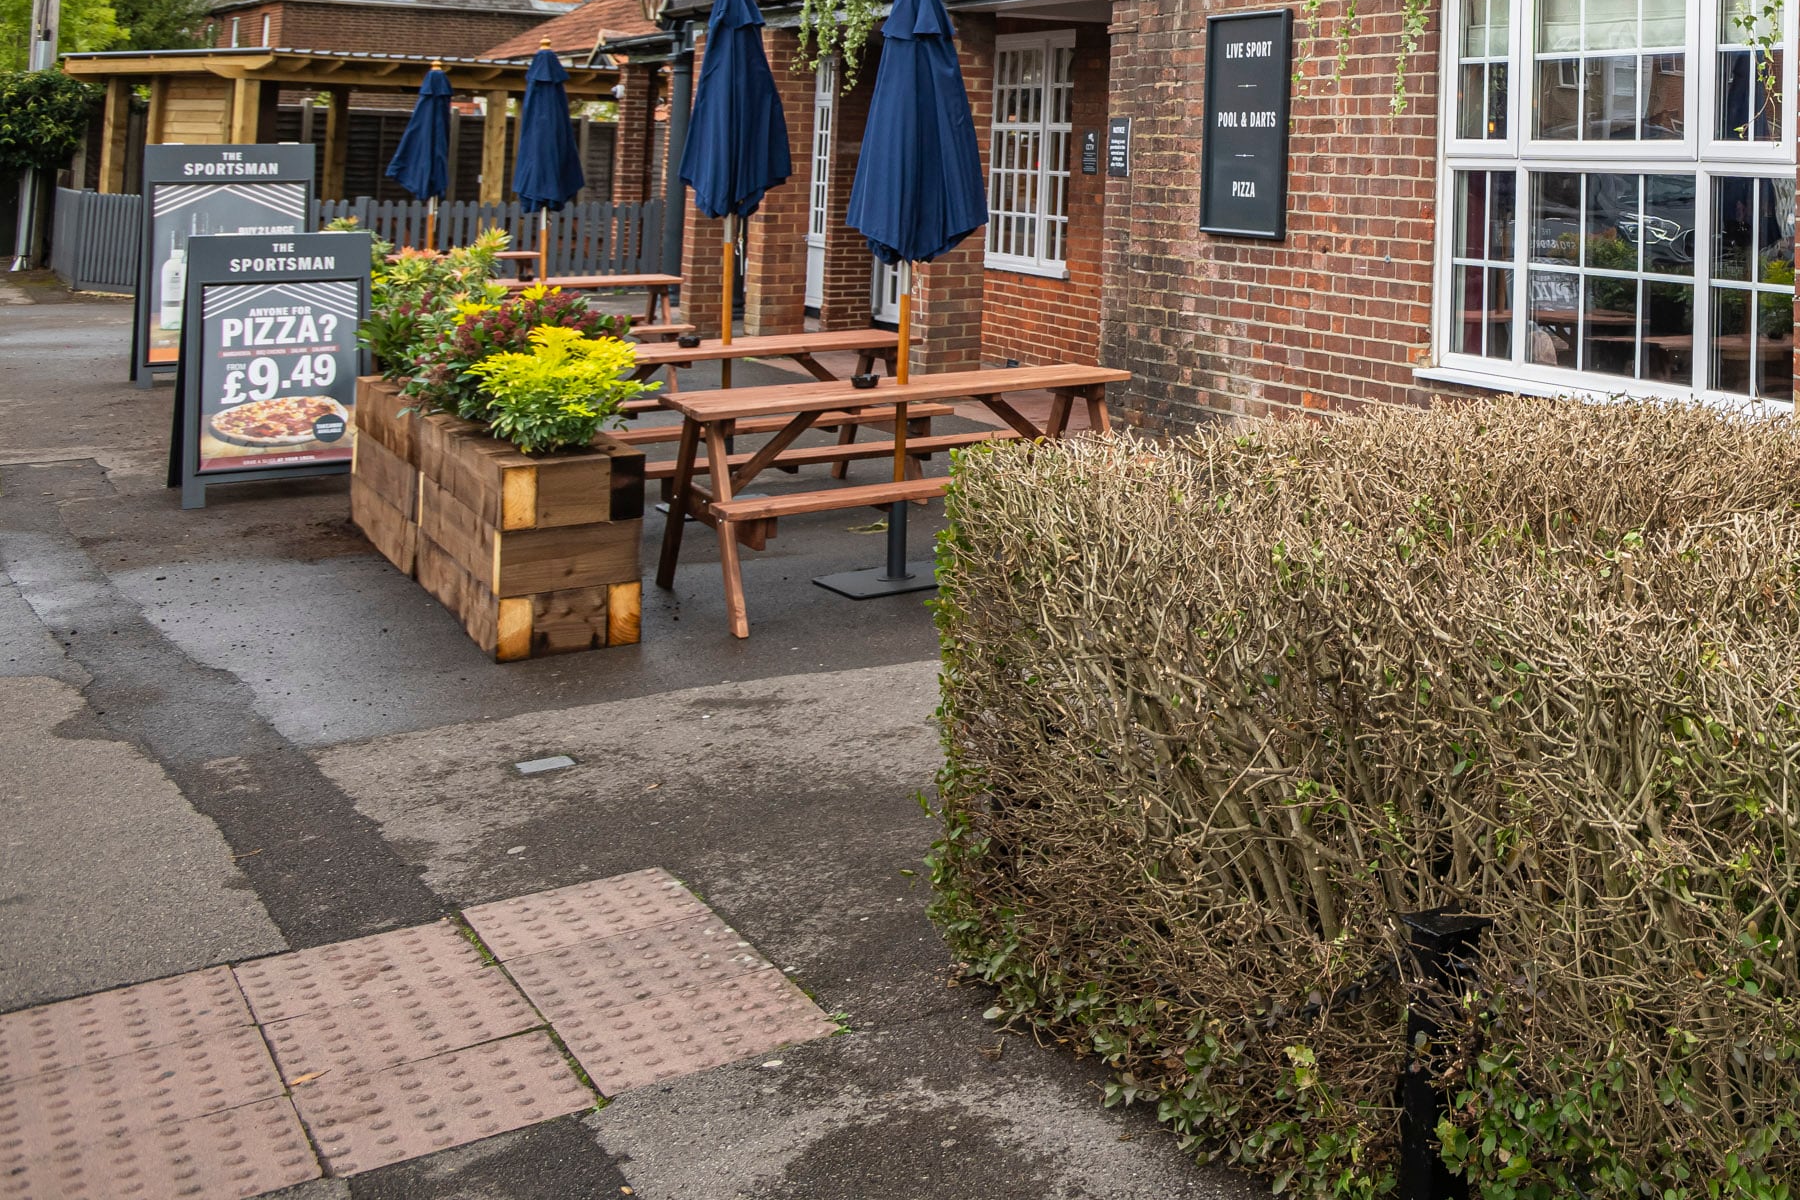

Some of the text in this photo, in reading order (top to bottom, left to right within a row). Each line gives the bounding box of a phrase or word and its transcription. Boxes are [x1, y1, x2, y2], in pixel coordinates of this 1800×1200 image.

[1226, 41, 1272, 59] LIVE SPORT
[1218, 111, 1276, 128] POOL & DARTS
[222, 152, 242, 161] THE
[184, 163, 278, 175] SPORTSMAN
[1232, 181, 1255, 197] PIZZA
[272, 243, 295, 252] THE
[230, 257, 335, 272] SPORTSMAN
[249, 306, 311, 316] ANYONE FOR
[222, 313, 338, 347] PIZZA?
[226, 363, 246, 371] FROM
[221, 353, 337, 404] £9.49
